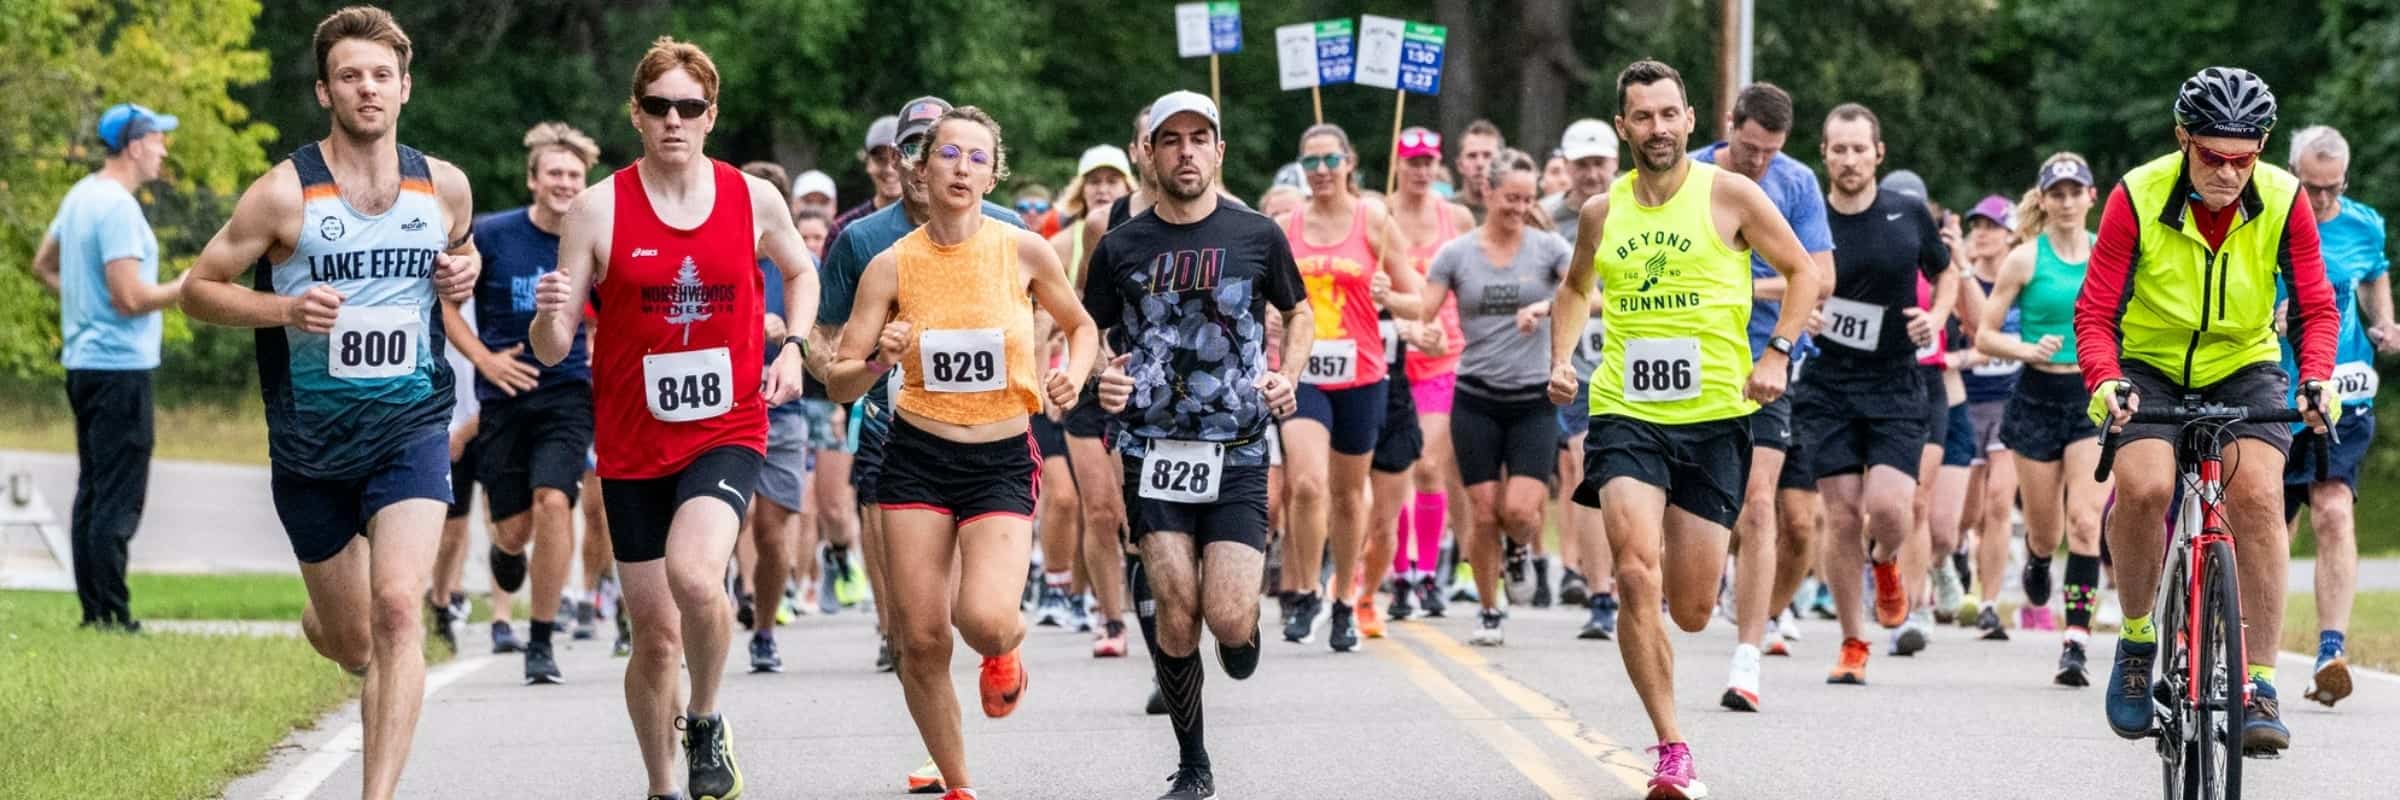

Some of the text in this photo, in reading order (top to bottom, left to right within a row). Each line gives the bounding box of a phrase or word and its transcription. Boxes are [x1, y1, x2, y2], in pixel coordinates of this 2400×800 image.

[1616, 231, 1692, 260] BEYOND
[307, 250, 366, 283] LAKE
[1150, 247, 1226, 296] LDN
[641, 283, 736, 303] NORTHWOODS
[641, 304, 734, 315] MINNESOTA
[1620, 292, 1700, 312] RUNNING
[1831, 312, 1868, 341] 781
[341, 329, 407, 367] 800
[932, 350, 995, 383] 829
[1308, 356, 1347, 377] 857
[1632, 358, 1691, 392] 886
[657, 372, 722, 412] 848
[1151, 458, 1210, 494] 828
